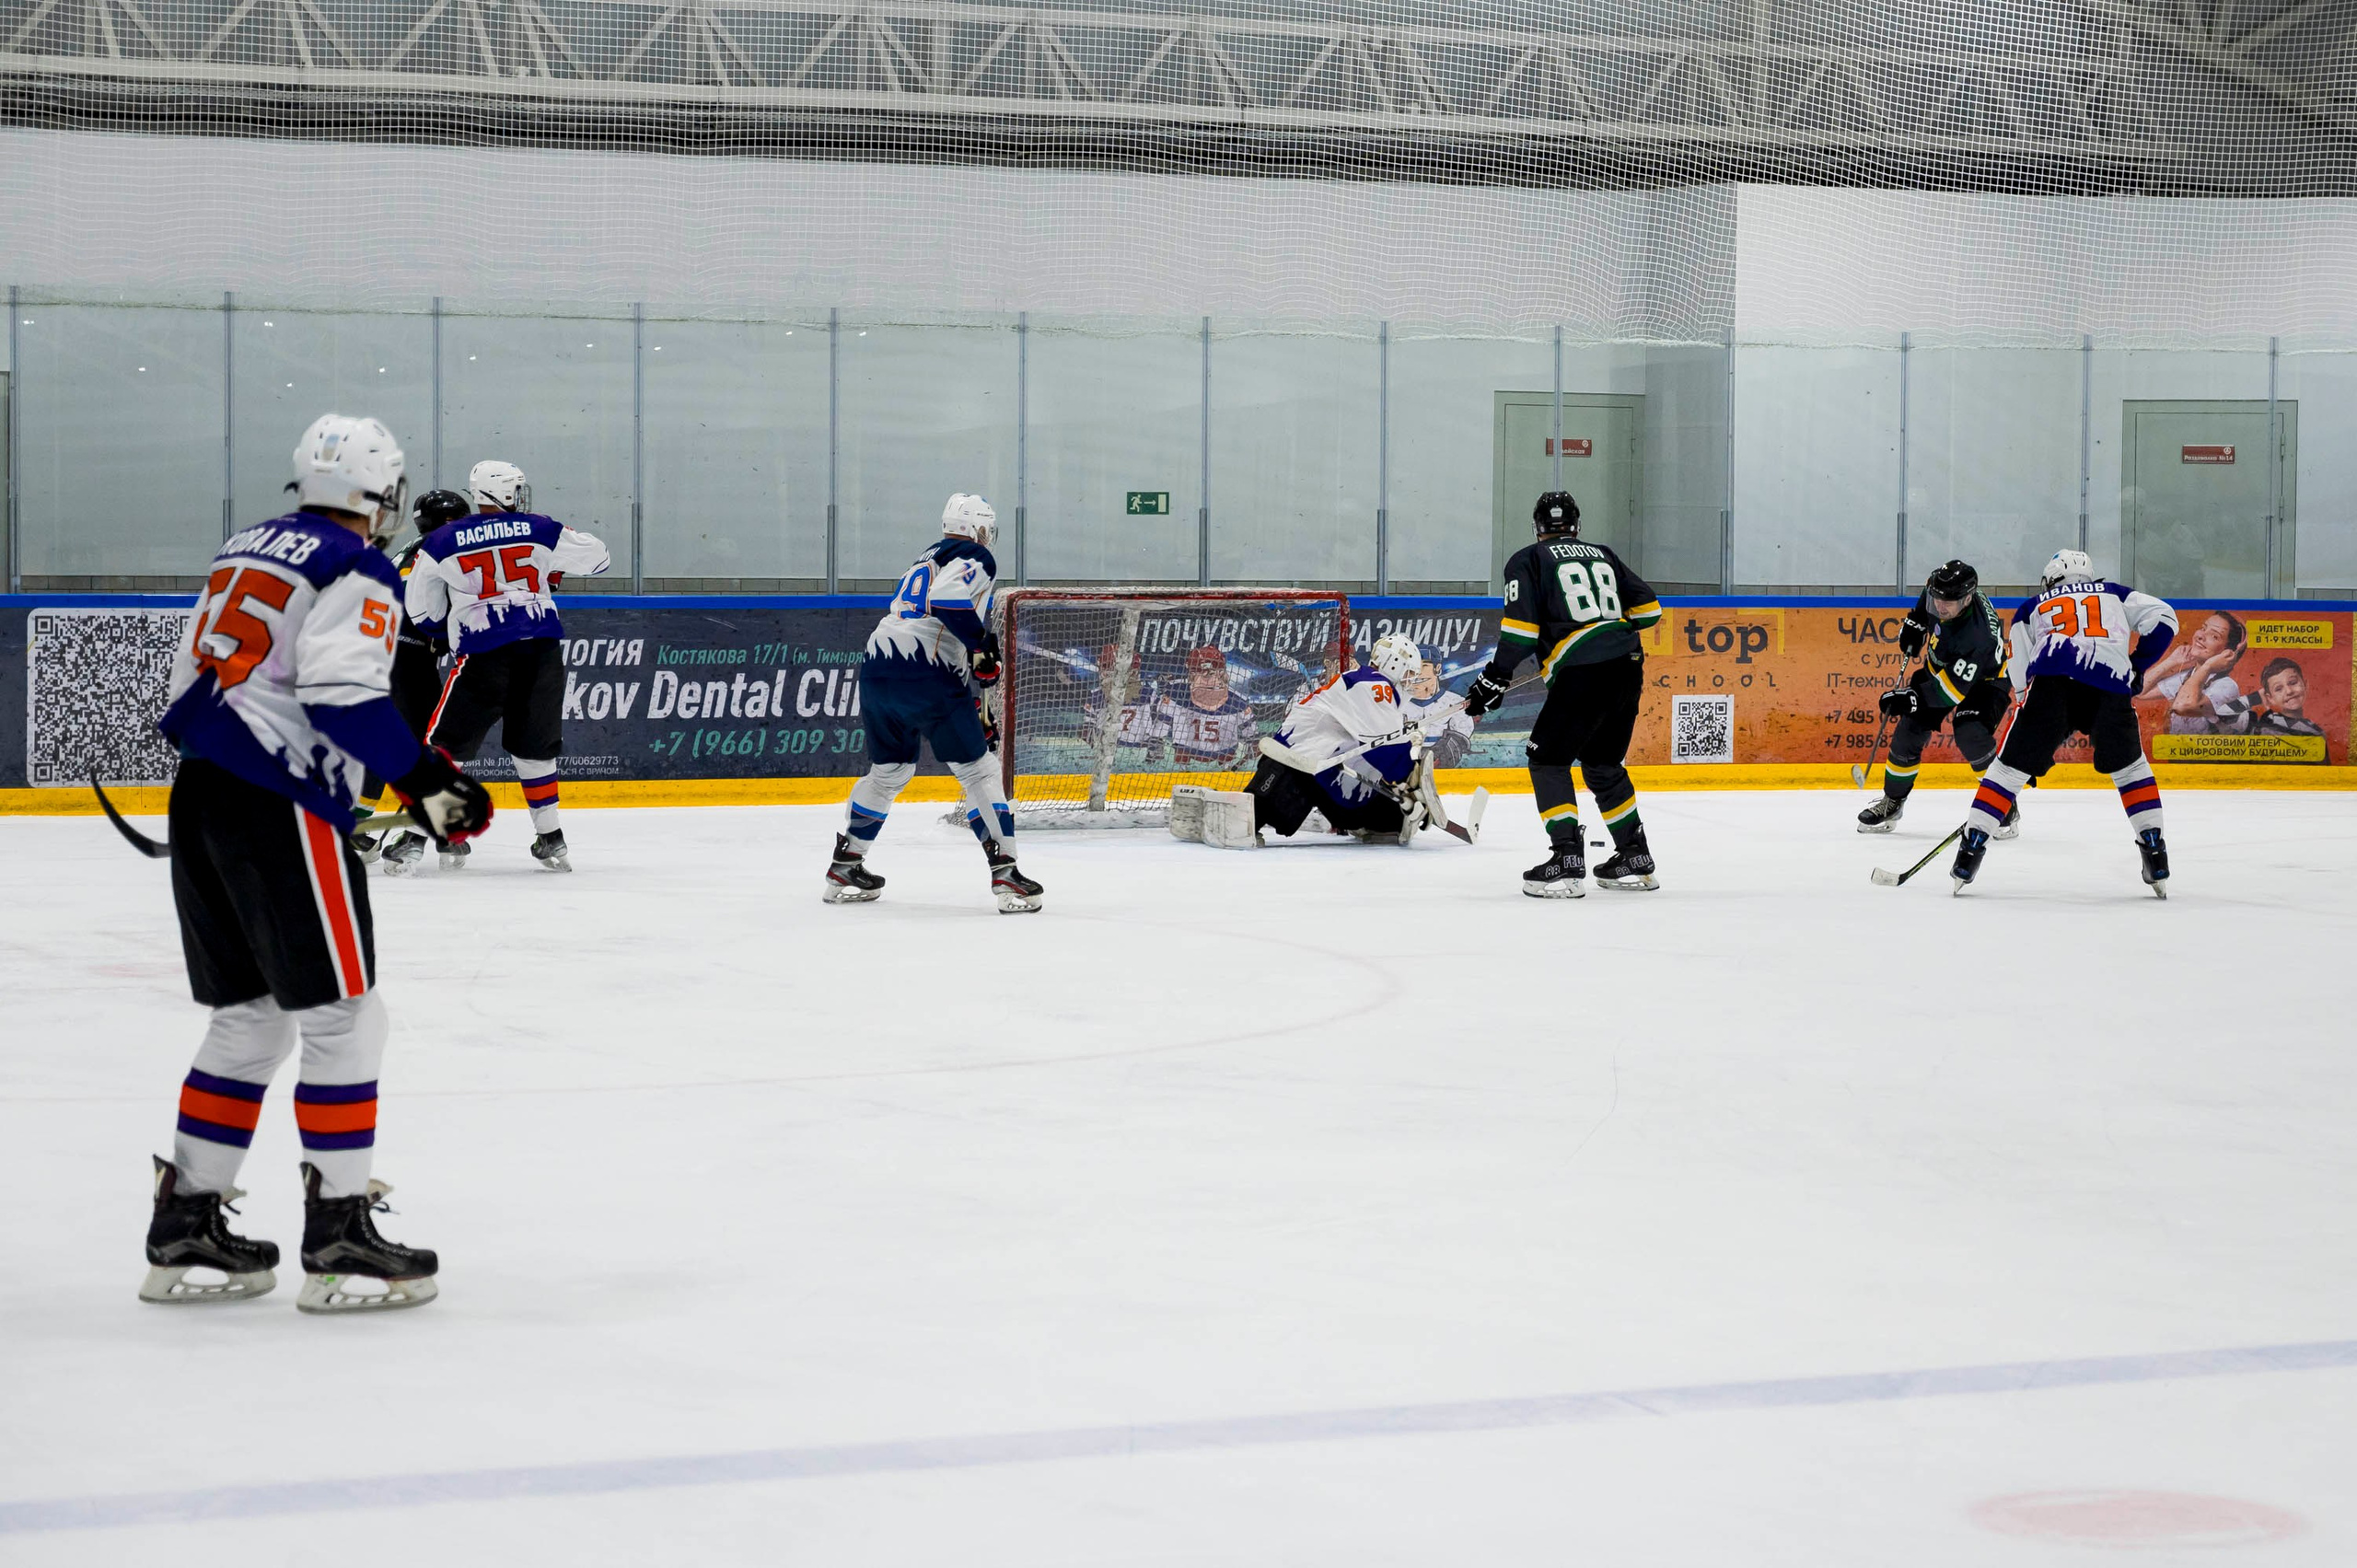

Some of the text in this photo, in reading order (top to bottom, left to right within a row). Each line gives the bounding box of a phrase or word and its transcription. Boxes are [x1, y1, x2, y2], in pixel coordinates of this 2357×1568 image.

[455, 521, 532, 547] ВАСИЛЬЕВ
[1549, 544, 1605, 559] FEDOTOV
[457, 545, 540, 600] 75
[1556, 560, 1622, 622] 88
[2038, 582, 2106, 601] ИВАНОВ
[2038, 595, 2109, 638] 31
[1139, 611, 1331, 653] ПОЧУВСТВУЙ
[1838, 617, 1906, 644] ЧАС
[2258, 625, 2320, 633] ИДЕТ НАБОР
[2264, 635, 2279, 644] 1-9
[2281, 635, 2323, 645] КЛАССЫ
[1684, 619, 1769, 664] top
[656, 645, 747, 666] Костякова
[753, 644, 788, 667] 17/1
[1953, 658, 1978, 682] 83
[561, 671, 642, 720] kov
[647, 668, 787, 720] Dental
[1371, 684, 1394, 704] 39
[1477, 672, 1507, 693] CCM
[1190, 719, 1221, 743] 15
[1370, 720, 1419, 749] CCM
[1825, 735, 1841, 749] +7
[1846, 735, 1874, 749] 985
[2196, 737, 2282, 748] ГОТОВИМ ДЕТЕЙ
[648, 728, 865, 760] +7 (966) 309 30
[2178, 748, 2247, 757] ЦИФРОВОМУ
[2248, 749, 2308, 758] БУДУЩЕМУ
